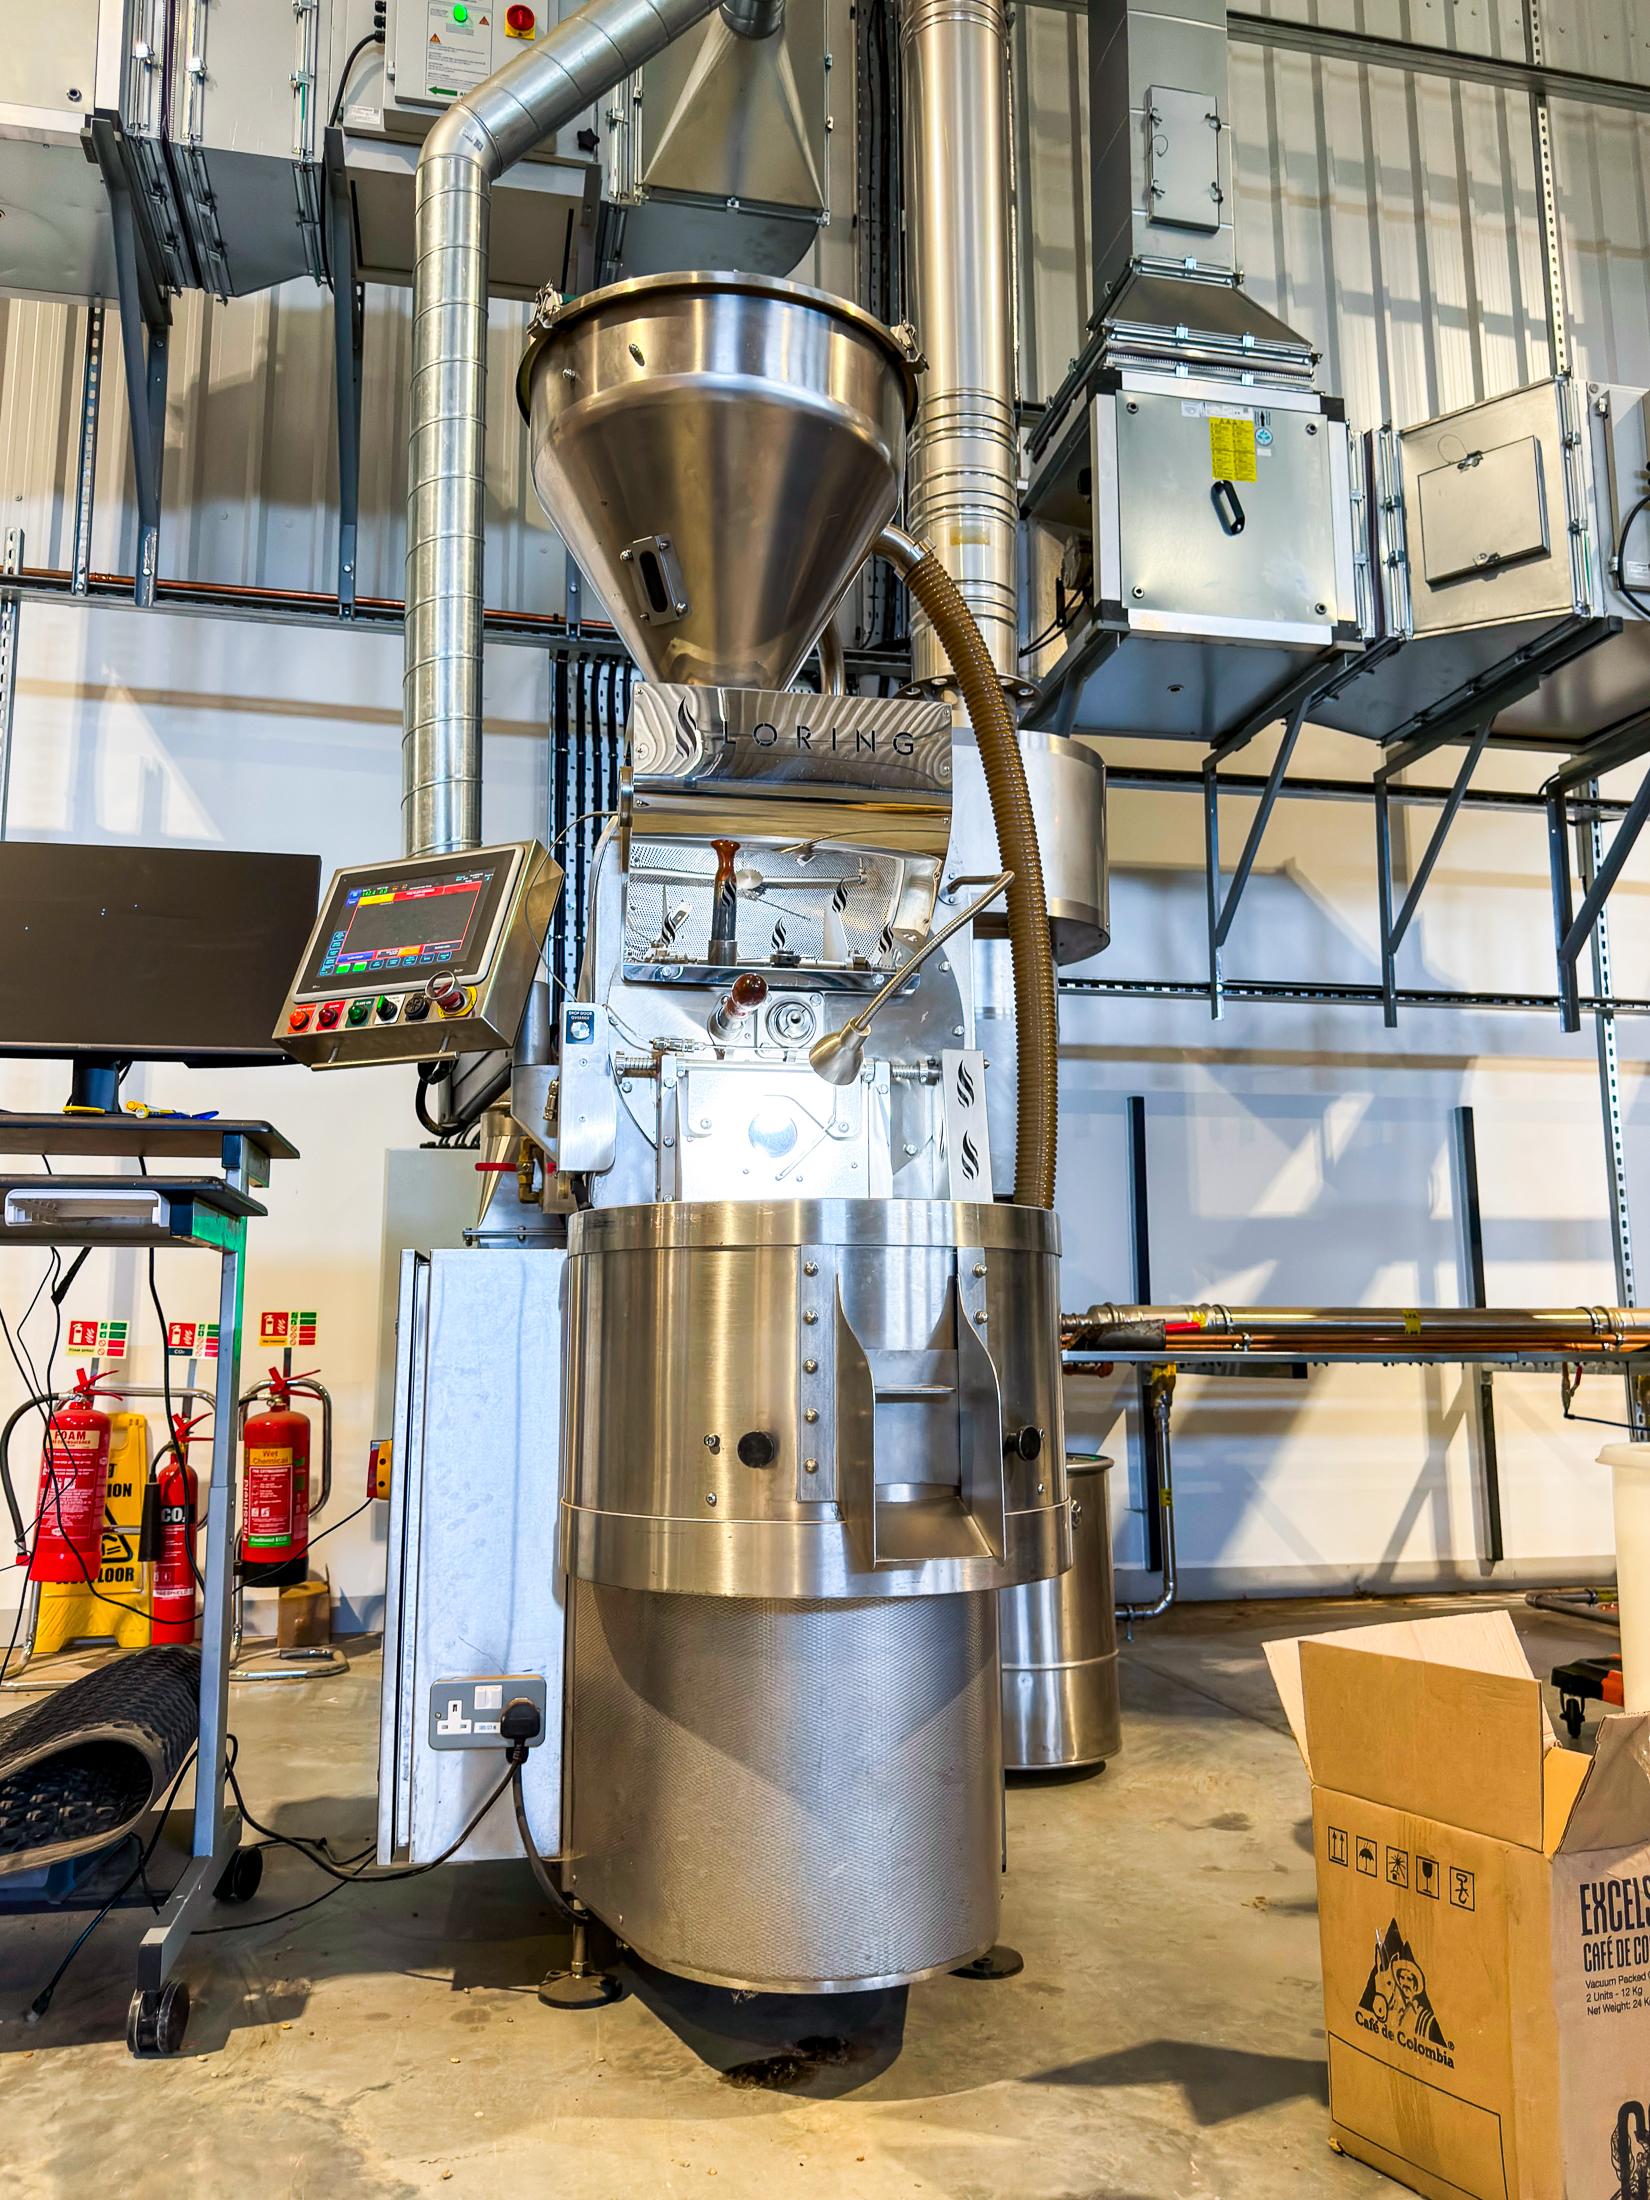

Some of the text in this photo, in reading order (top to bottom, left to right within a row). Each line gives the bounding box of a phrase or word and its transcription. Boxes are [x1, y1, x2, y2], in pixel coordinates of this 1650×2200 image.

[723, 720, 914, 756] LORING
[54, 1430, 86, 1440] FOAM
[262, 1449, 279, 1457] Wet
[98, 1567, 135, 1583] LOOR
[1583, 1935, 1614, 1973] CAFÉ
[1616, 1937, 1632, 1968] DE
[1585, 1976, 1616, 1990] Vacuum
[1618, 1971, 1647, 1985] Packed
[1586, 1994, 1592, 2003] 2
[1593, 1990, 1614, 2002] Units
[1621, 1987, 1631, 1997] 12
[1632, 1985, 1643, 1997] Kg
[1587, 2005, 1601, 2016] Net
[1602, 2000, 1631, 2014] Weight:
[1632, 1998, 1642, 2009] 24
[1355, 2010, 1455, 2070] Café de Colombia
